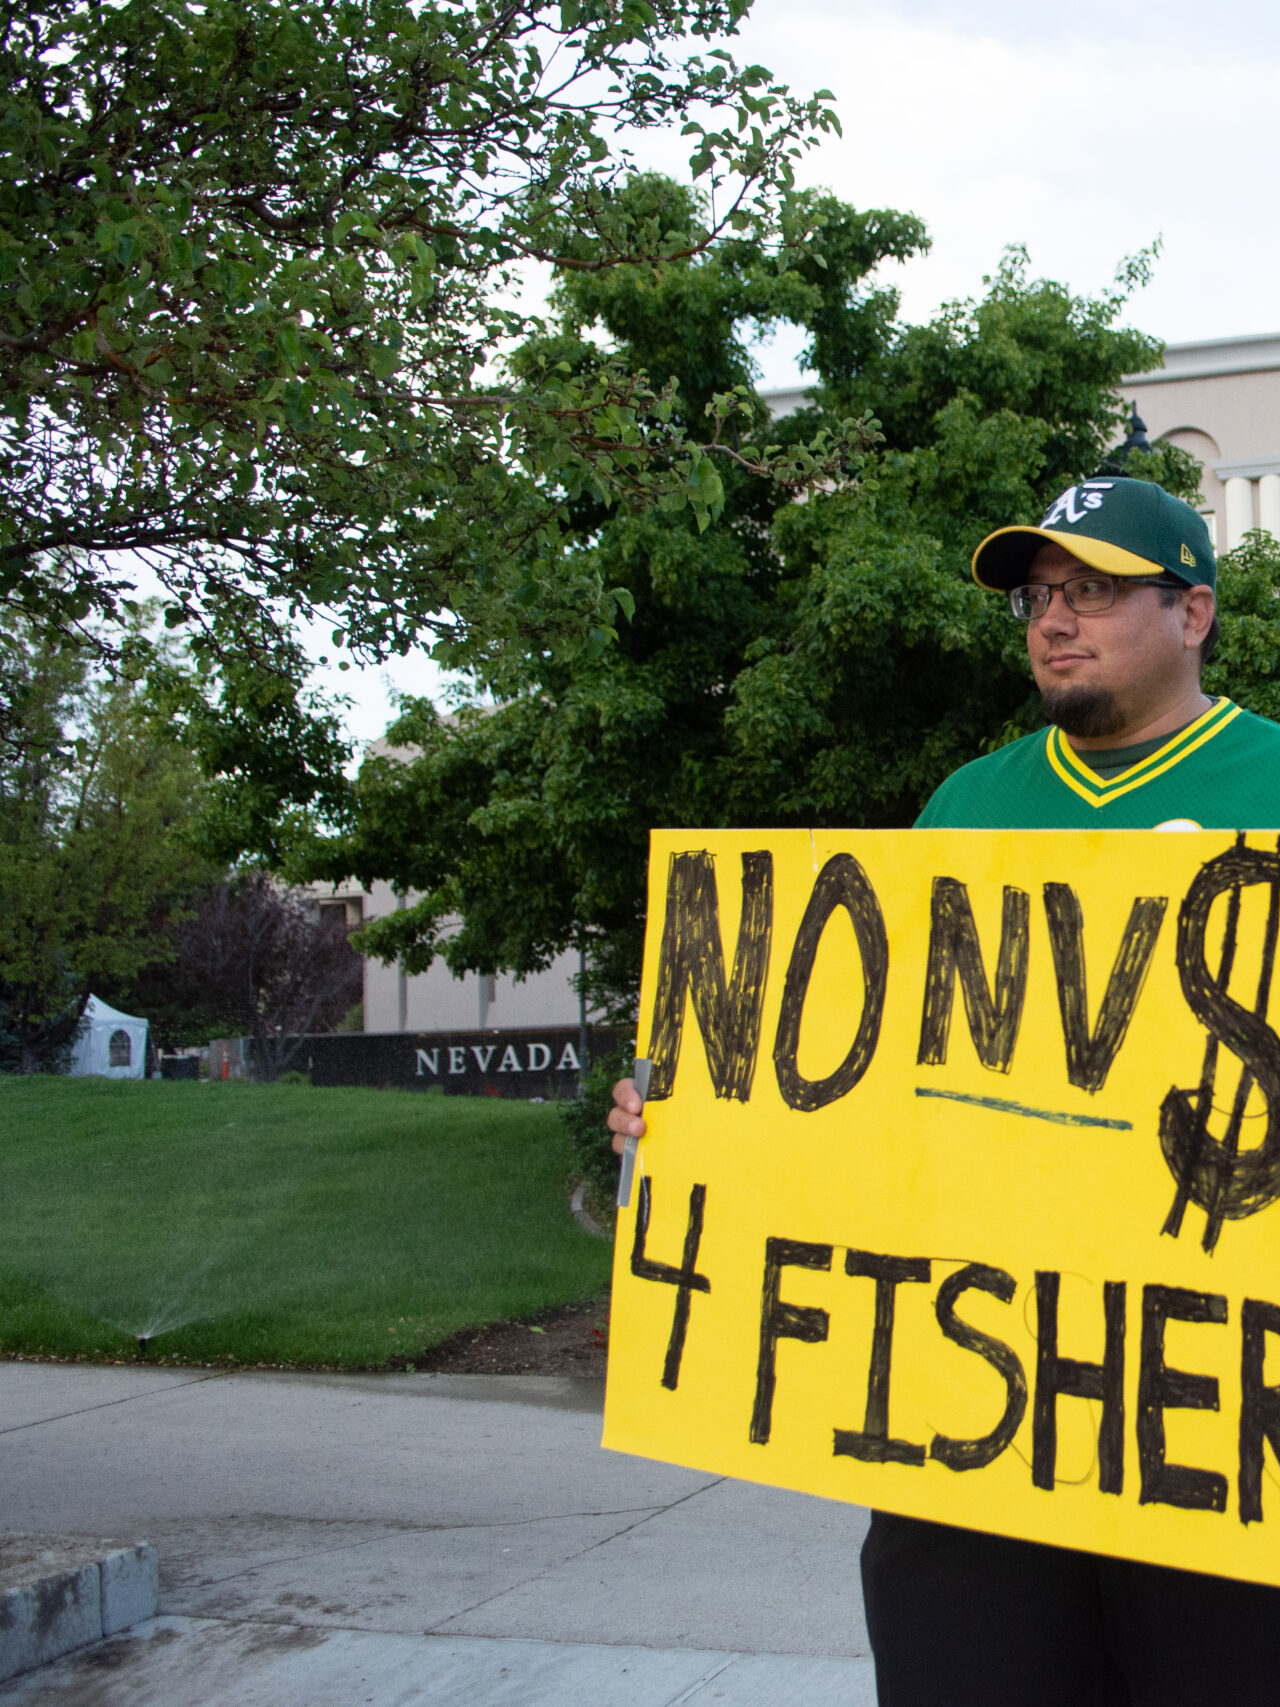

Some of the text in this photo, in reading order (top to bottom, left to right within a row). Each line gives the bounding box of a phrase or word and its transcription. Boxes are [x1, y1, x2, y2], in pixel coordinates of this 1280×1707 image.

[415, 1042, 582, 1076] NEVADA
[647, 849, 889, 1113] NO
[630, 1175, 711, 1391] 4
